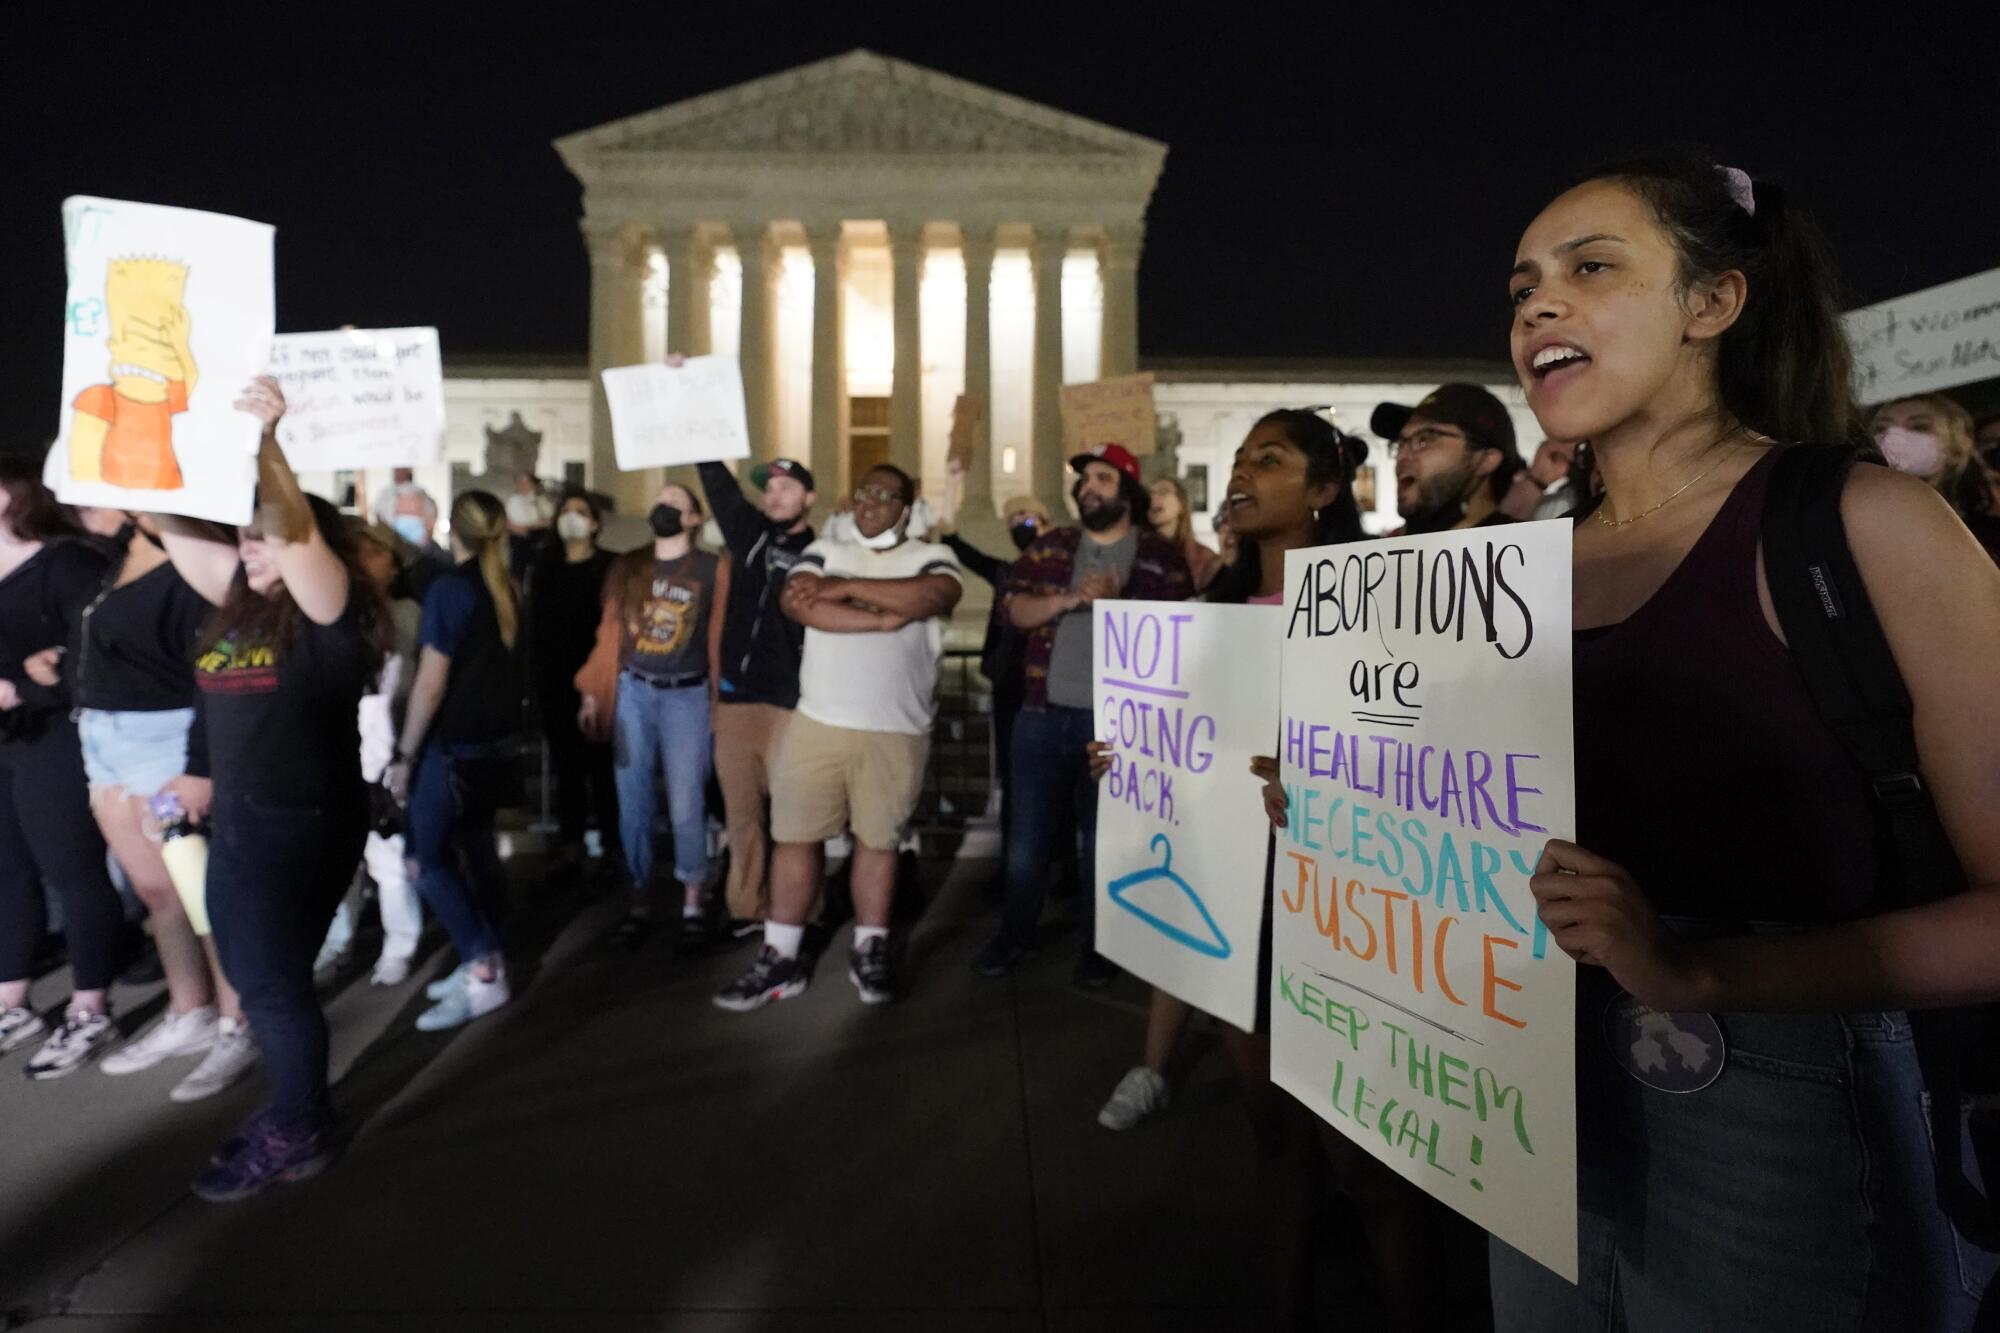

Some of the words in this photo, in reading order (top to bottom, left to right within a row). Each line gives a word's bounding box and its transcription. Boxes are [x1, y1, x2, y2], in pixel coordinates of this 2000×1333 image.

[1104, 611, 1193, 685] NOT
[1287, 541, 1533, 660] ABORTIONS
[1103, 696, 1216, 773] GOING
[1349, 659, 1422, 708] are
[1107, 753, 1180, 826] BACK.
[1287, 716, 1549, 838] HEALTHCARE
[1284, 783, 1549, 960] NECESSARY
[1282, 851, 1528, 1029] JUSTICE
[1280, 963, 1370, 1051] KEEP
[1381, 1020, 1536, 1156] THEM
